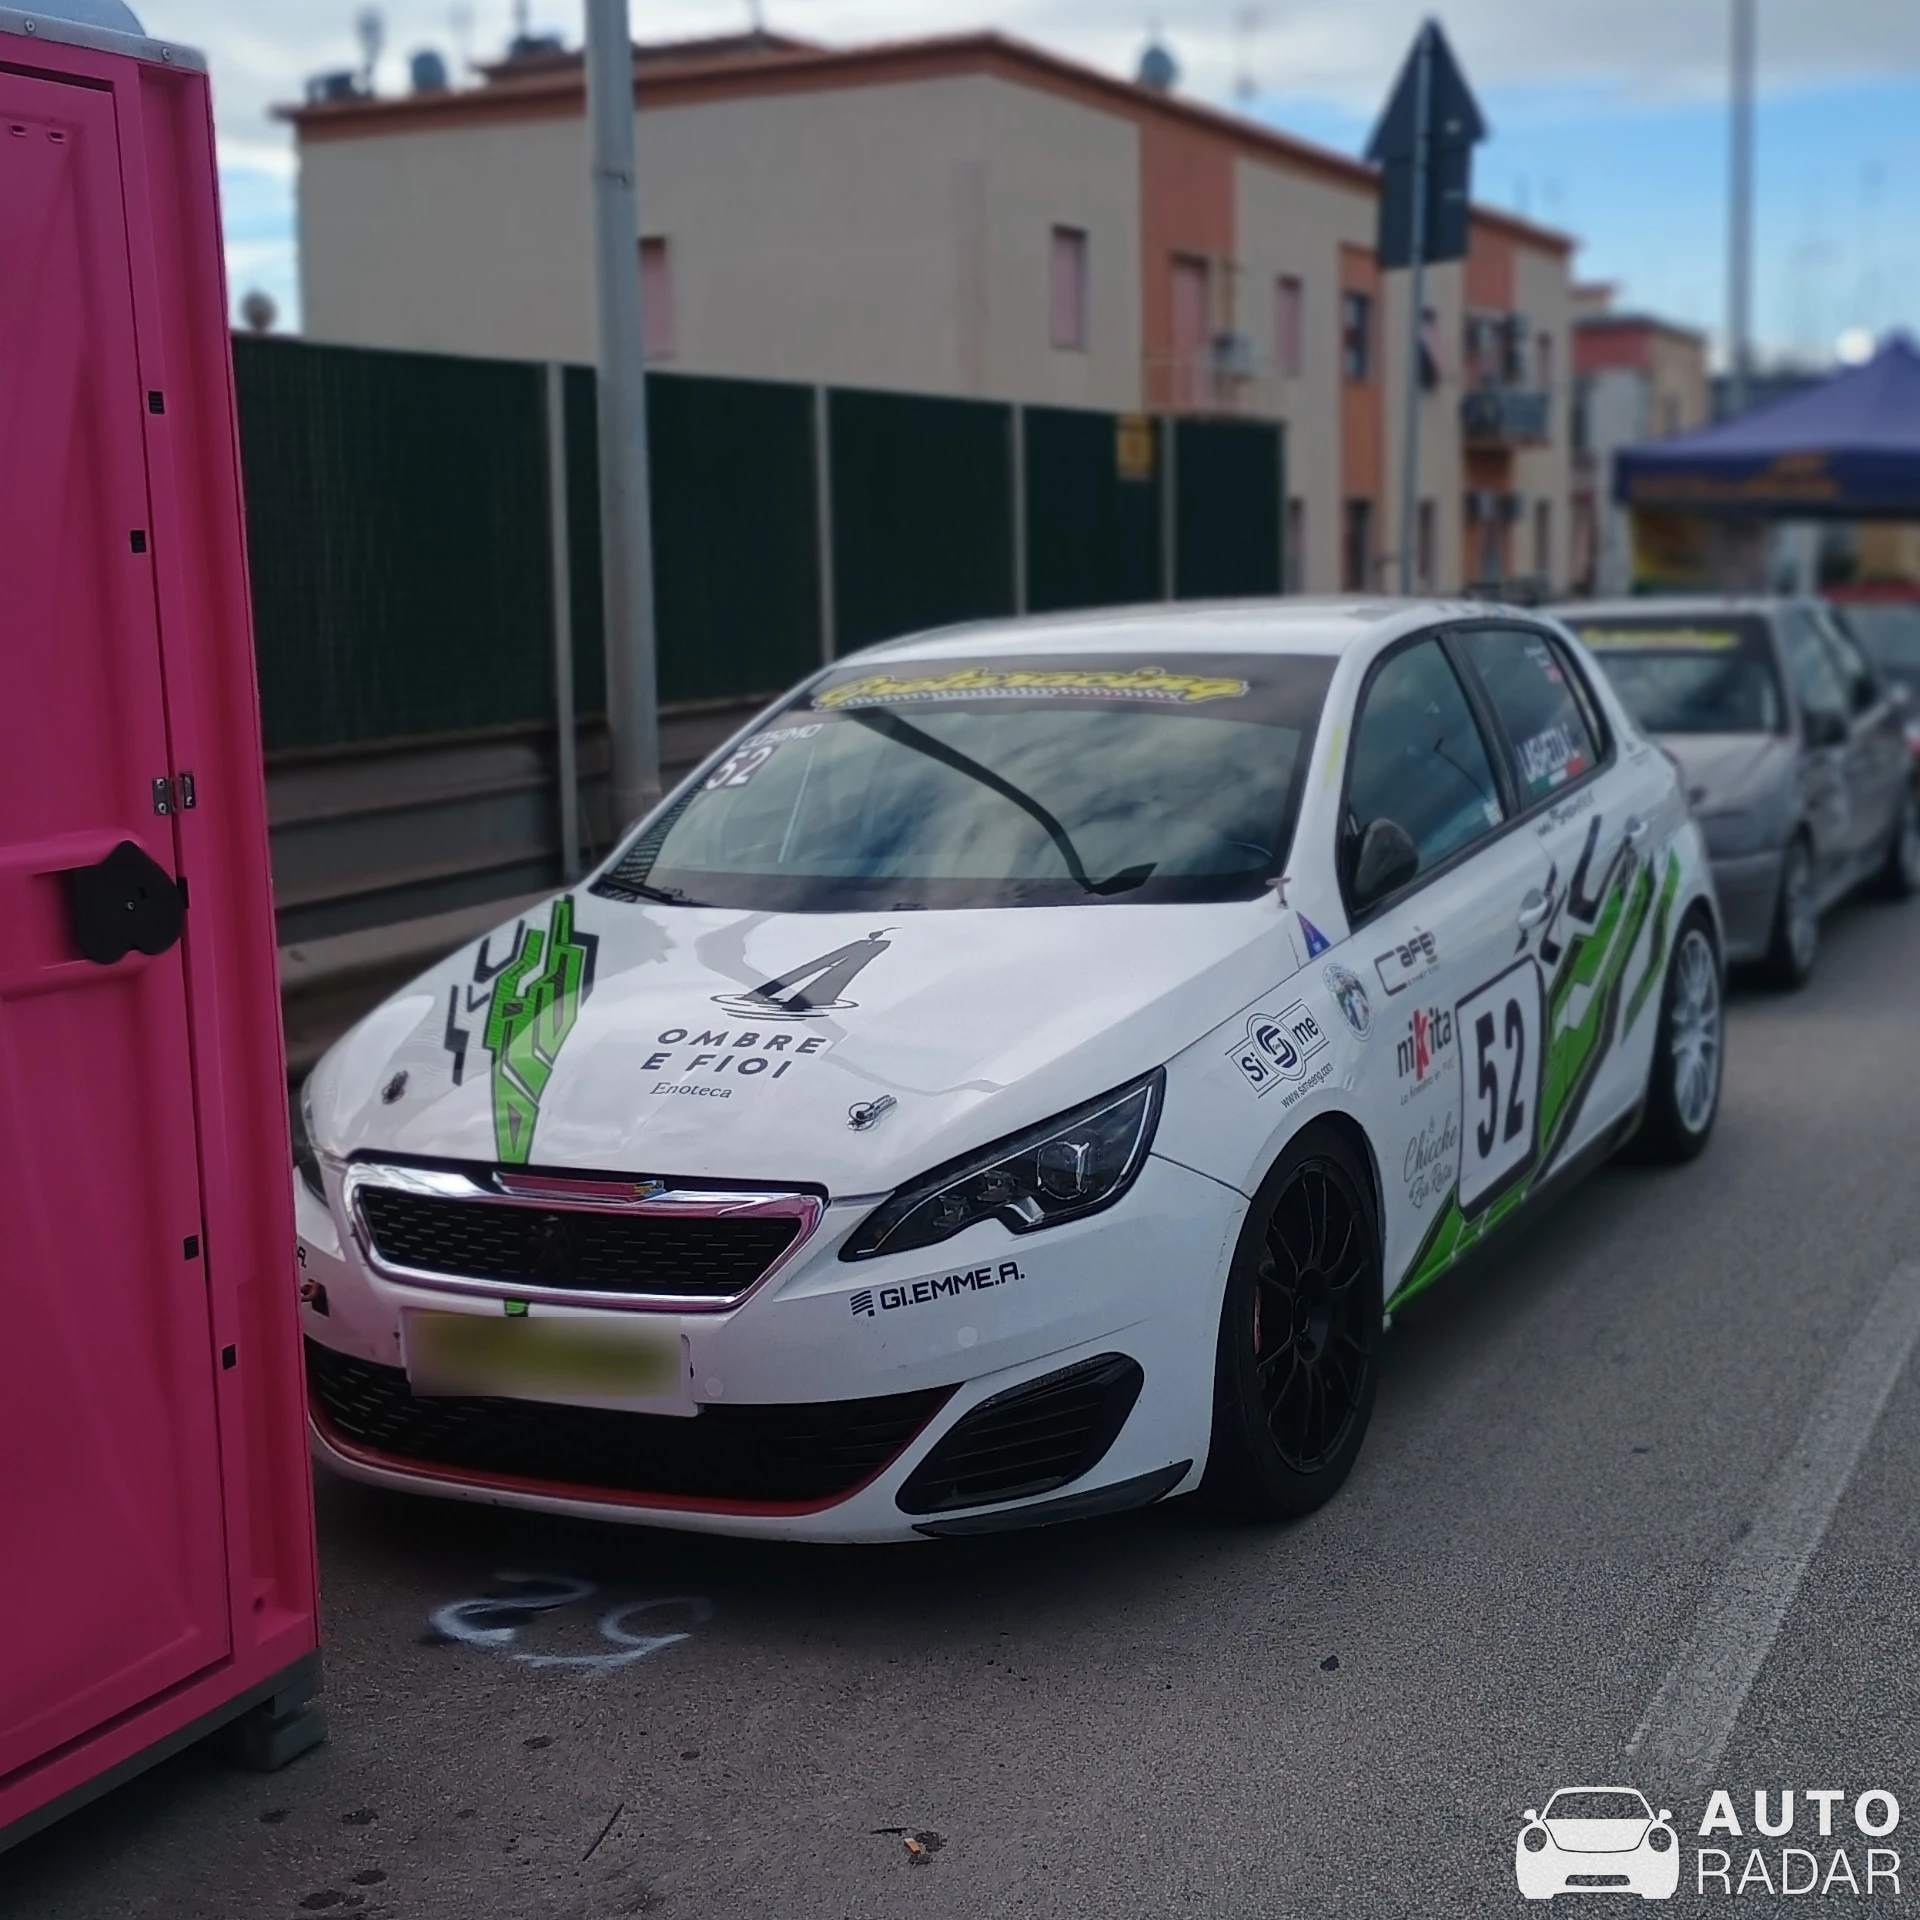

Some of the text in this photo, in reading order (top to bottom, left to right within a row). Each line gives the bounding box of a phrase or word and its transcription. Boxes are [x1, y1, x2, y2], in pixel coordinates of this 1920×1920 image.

[706, 746, 772, 789] 52
[657, 1028, 827, 1054] OMBRE
[1397, 1007, 1452, 1082] nikita
[640, 1052, 792, 1079] E FIOI
[1475, 998, 1525, 1160] 52
[650, 1082, 733, 1098] Enoteca
[879, 1261, 1026, 1310] GI.EMME.A.
